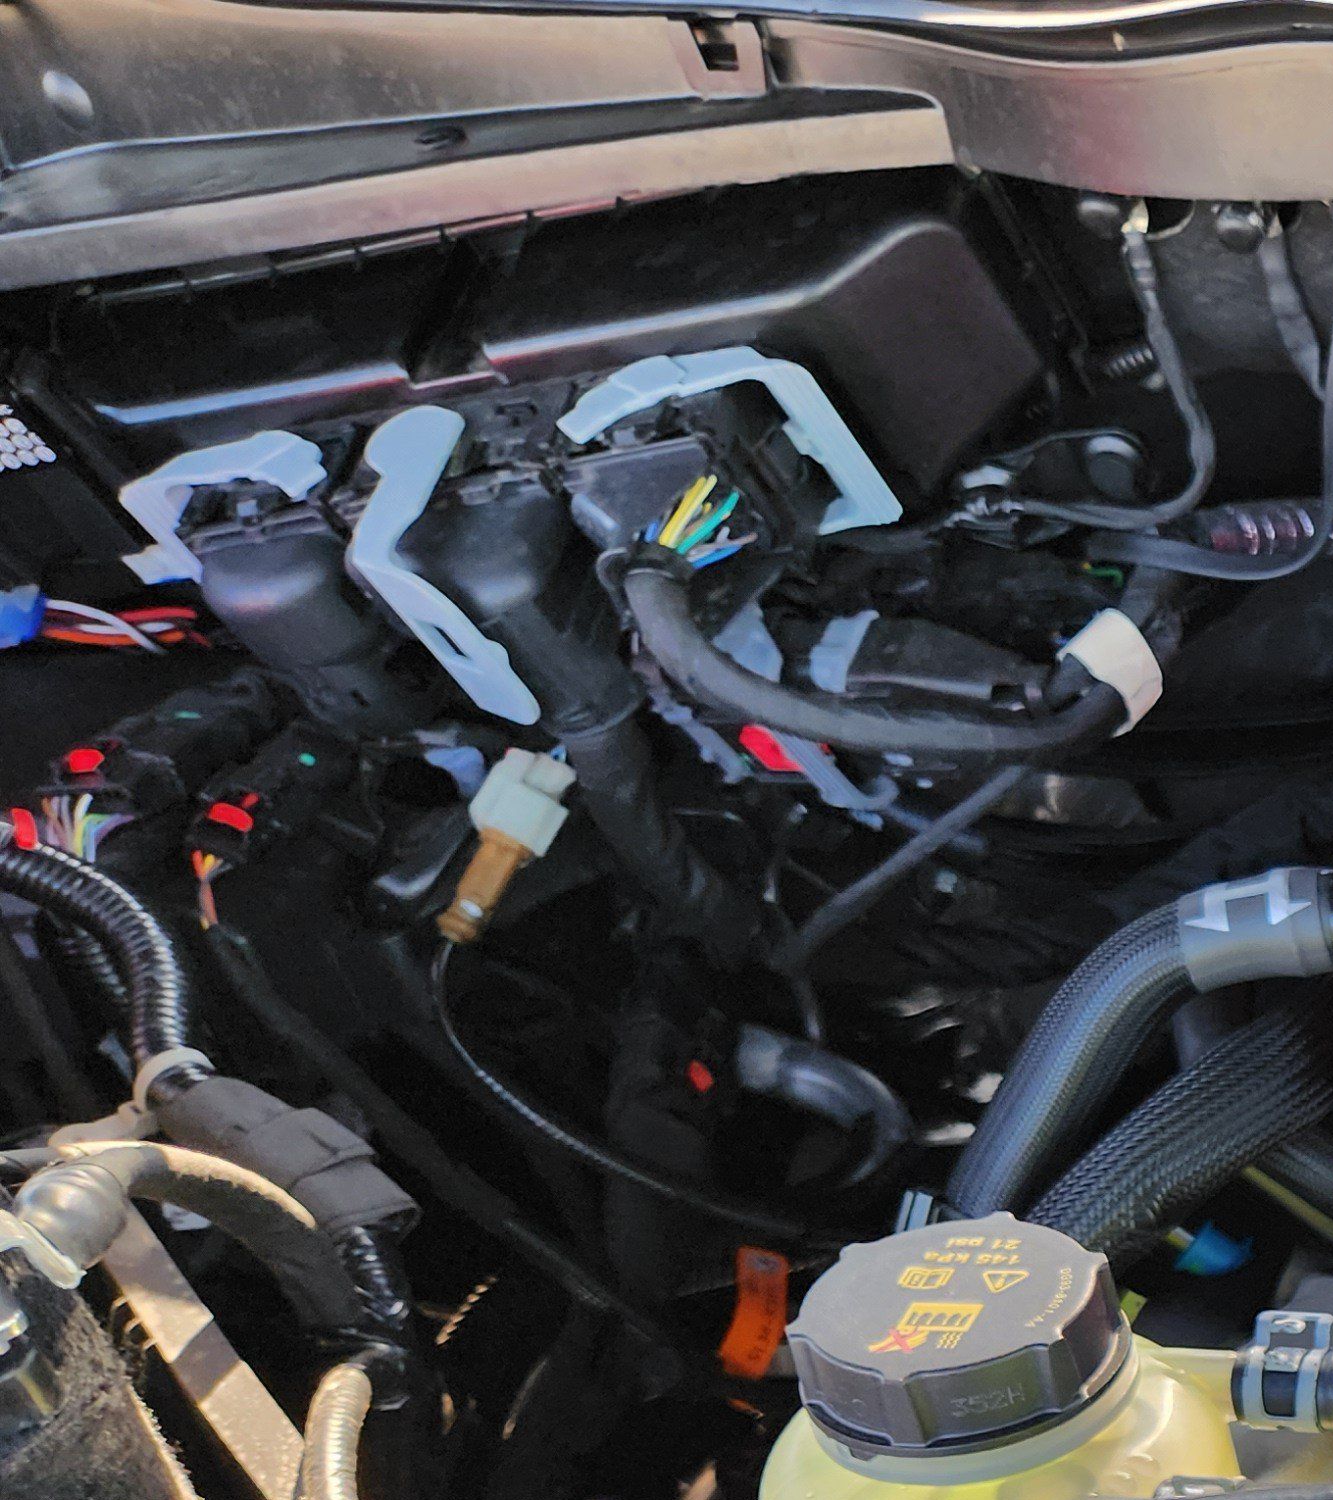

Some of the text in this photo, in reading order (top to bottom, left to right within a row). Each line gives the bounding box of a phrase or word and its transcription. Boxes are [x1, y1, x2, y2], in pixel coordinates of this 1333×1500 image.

[946, 1236, 1022, 1250] 21 psi
[923, 1251, 1021, 1266] 145 kPa
